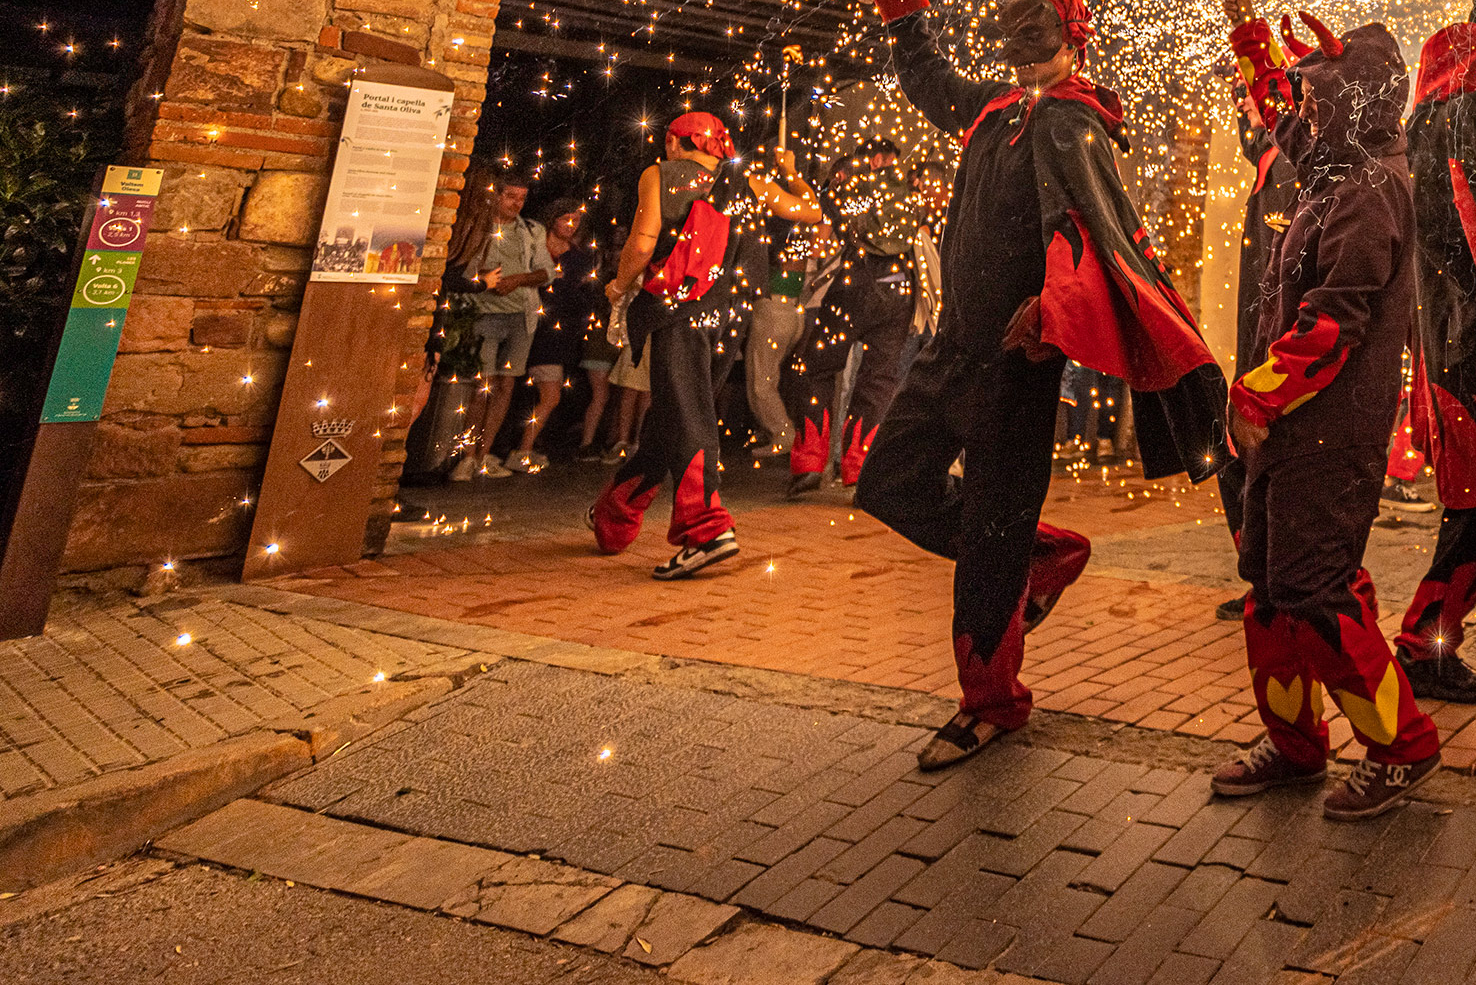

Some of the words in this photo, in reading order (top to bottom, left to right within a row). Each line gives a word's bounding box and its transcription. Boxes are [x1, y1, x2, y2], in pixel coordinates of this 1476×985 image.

[361, 101, 372, 109] de
[374, 103, 398, 111] Santa
[363, 93, 390, 103] Portal
[396, 99, 426, 107] capella
